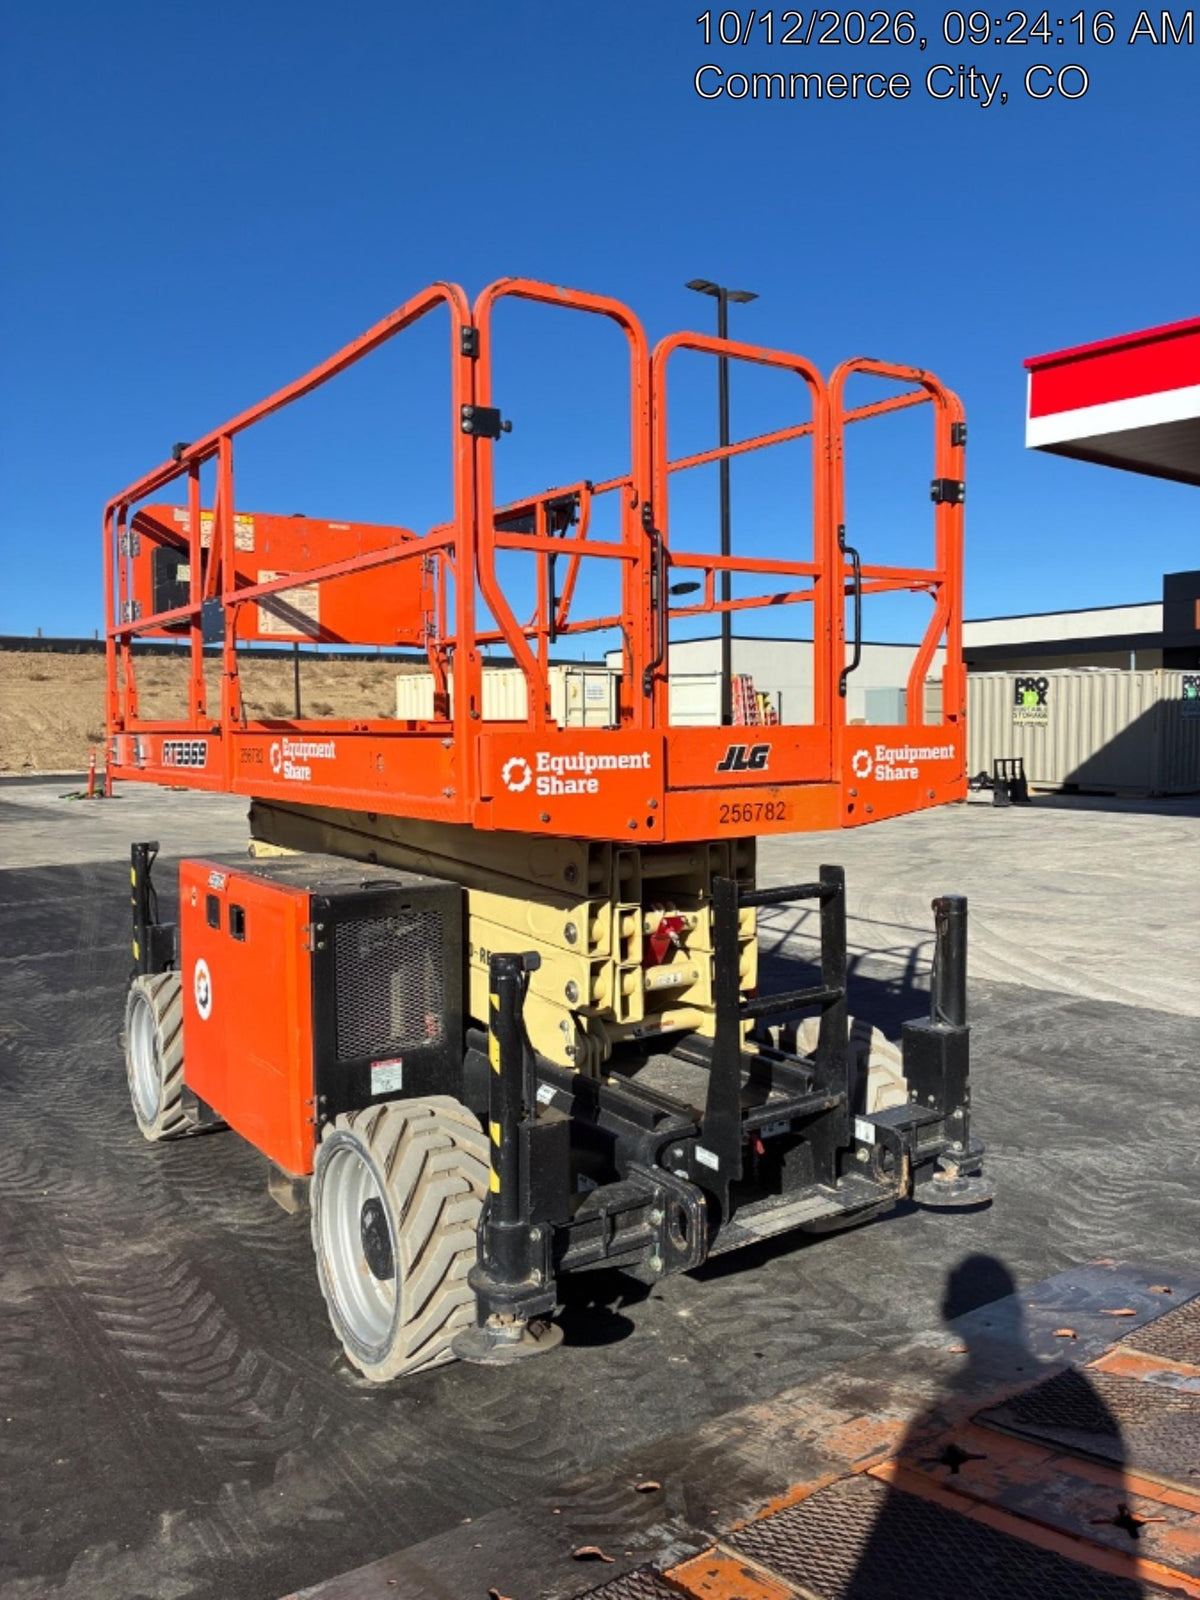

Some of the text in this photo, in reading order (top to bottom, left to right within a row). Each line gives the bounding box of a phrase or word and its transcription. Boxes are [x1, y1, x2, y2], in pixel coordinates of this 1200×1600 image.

[1015, 676, 1049, 692] PRO
[281, 738, 336, 762] Equipment
[716, 744, 771, 772] JLG
[875, 744, 955, 765] Equipment
[283, 760, 312, 781] Share
[536, 751, 651, 776] Equipment
[875, 765, 919, 781] Share
[536, 776, 599, 796] Share
[719, 801, 786, 824] 256782
